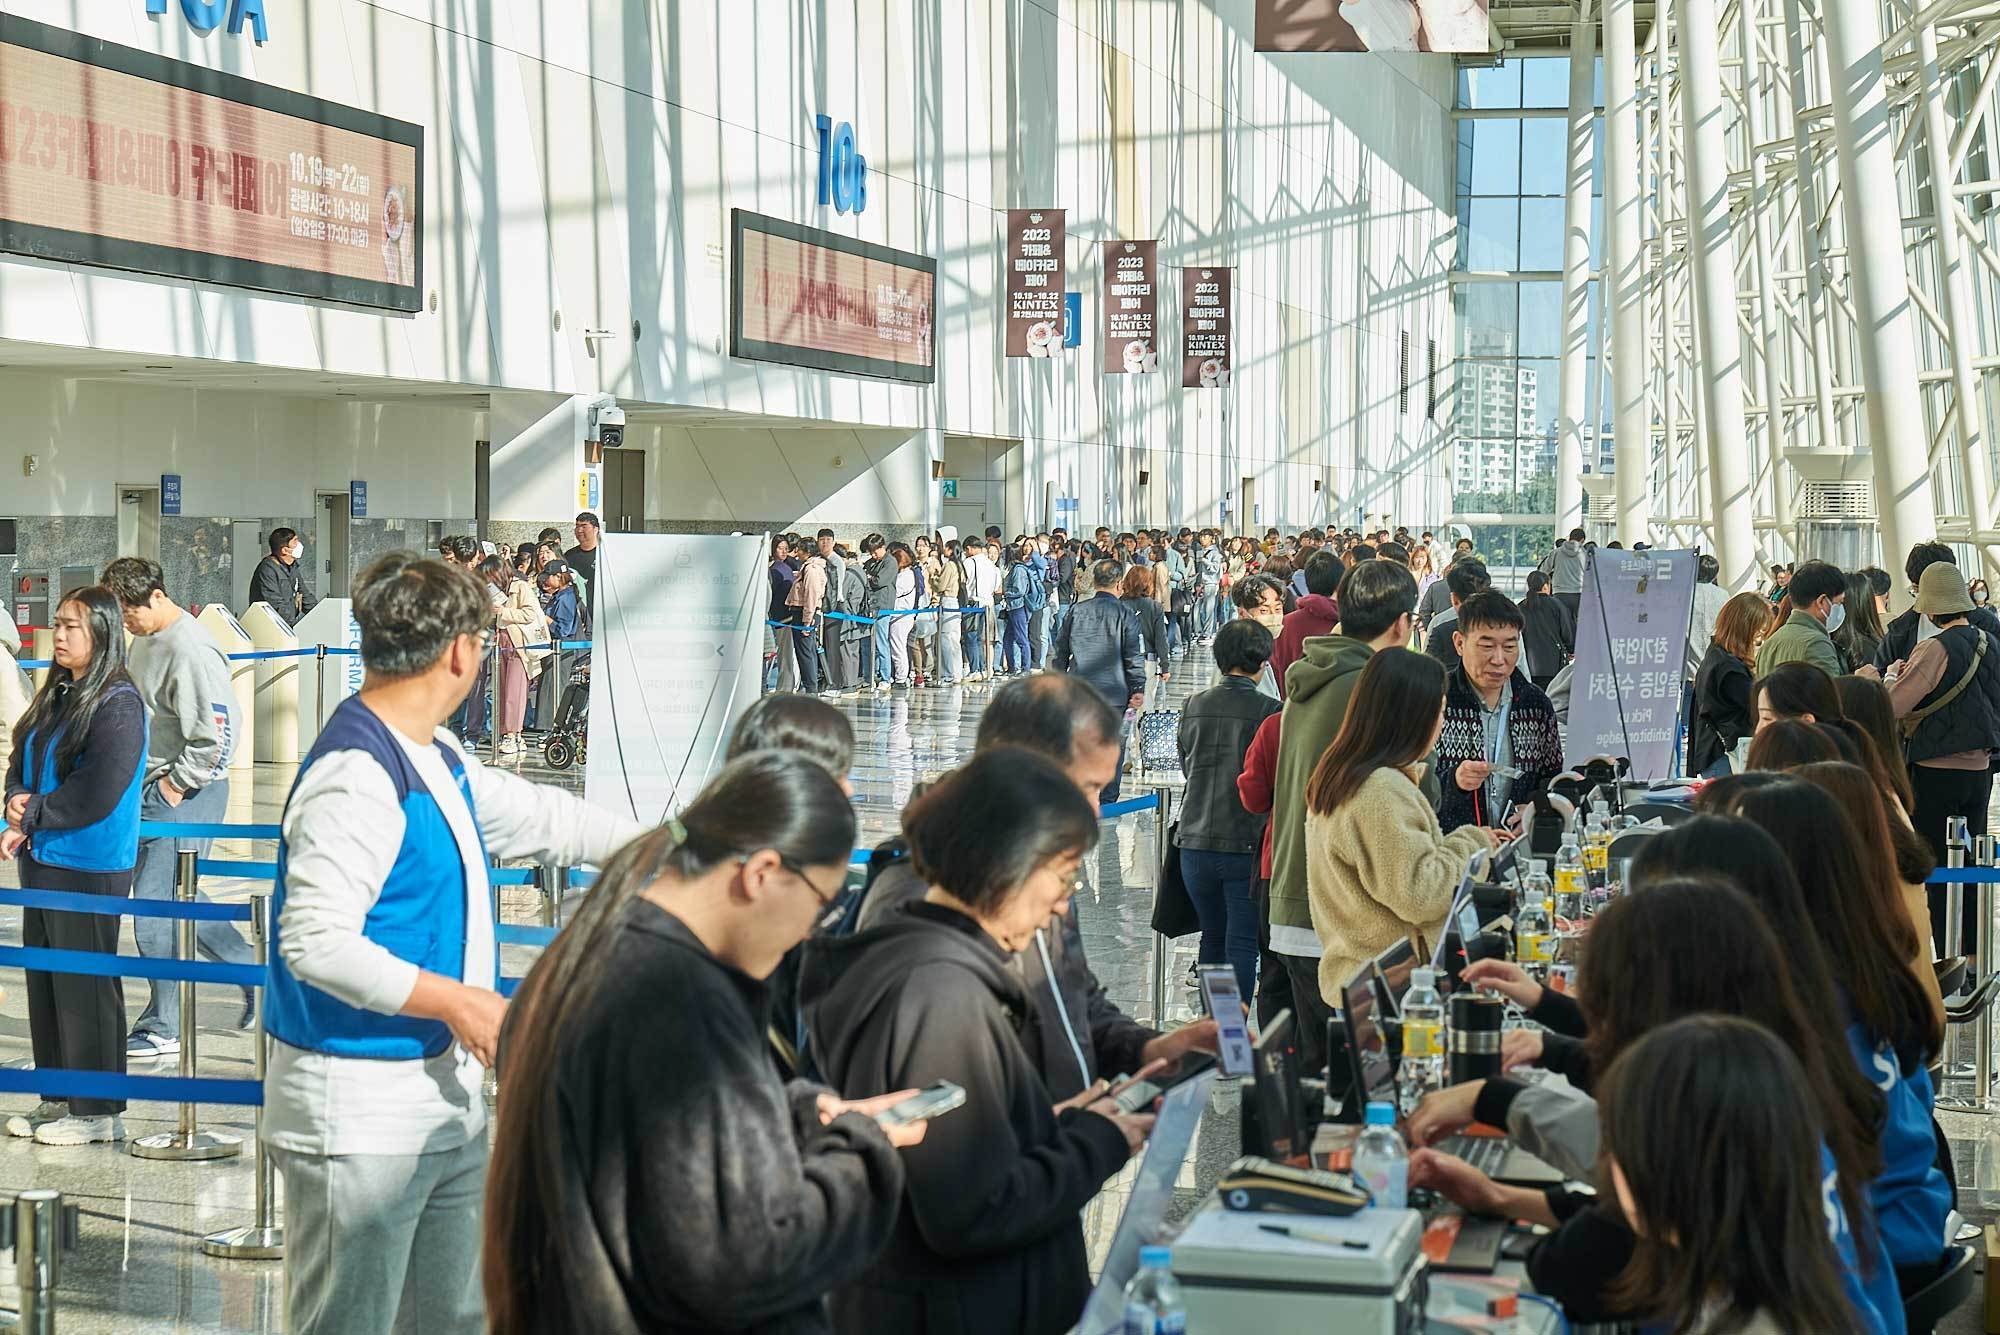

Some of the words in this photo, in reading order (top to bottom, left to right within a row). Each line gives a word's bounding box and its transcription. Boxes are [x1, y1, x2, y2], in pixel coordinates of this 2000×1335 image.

[816, 113, 867, 216] 10B
[1022, 229, 1051, 241] 2023
[1021, 243, 1052, 257] 카페&
[1014, 258, 1058, 272] 베이커리
[1117, 257, 1144, 269] 2023
[1024, 274, 1048, 287] 페어
[1116, 270, 1145, 283] 카페&
[1111, 284, 1151, 296] 베이커리
[1195, 282, 1219, 294] 2023
[1013, 300, 1058, 310] KINTEX
[1120, 297, 1141, 310] 페어
[1194, 295, 1220, 306] 카페&
[1189, 307, 1225, 318] 베이커리
[1110, 321, 1152, 330] KINTEX
[1197, 319, 1217, 331] 페어
[1188, 341, 1226, 350] KINTEX
